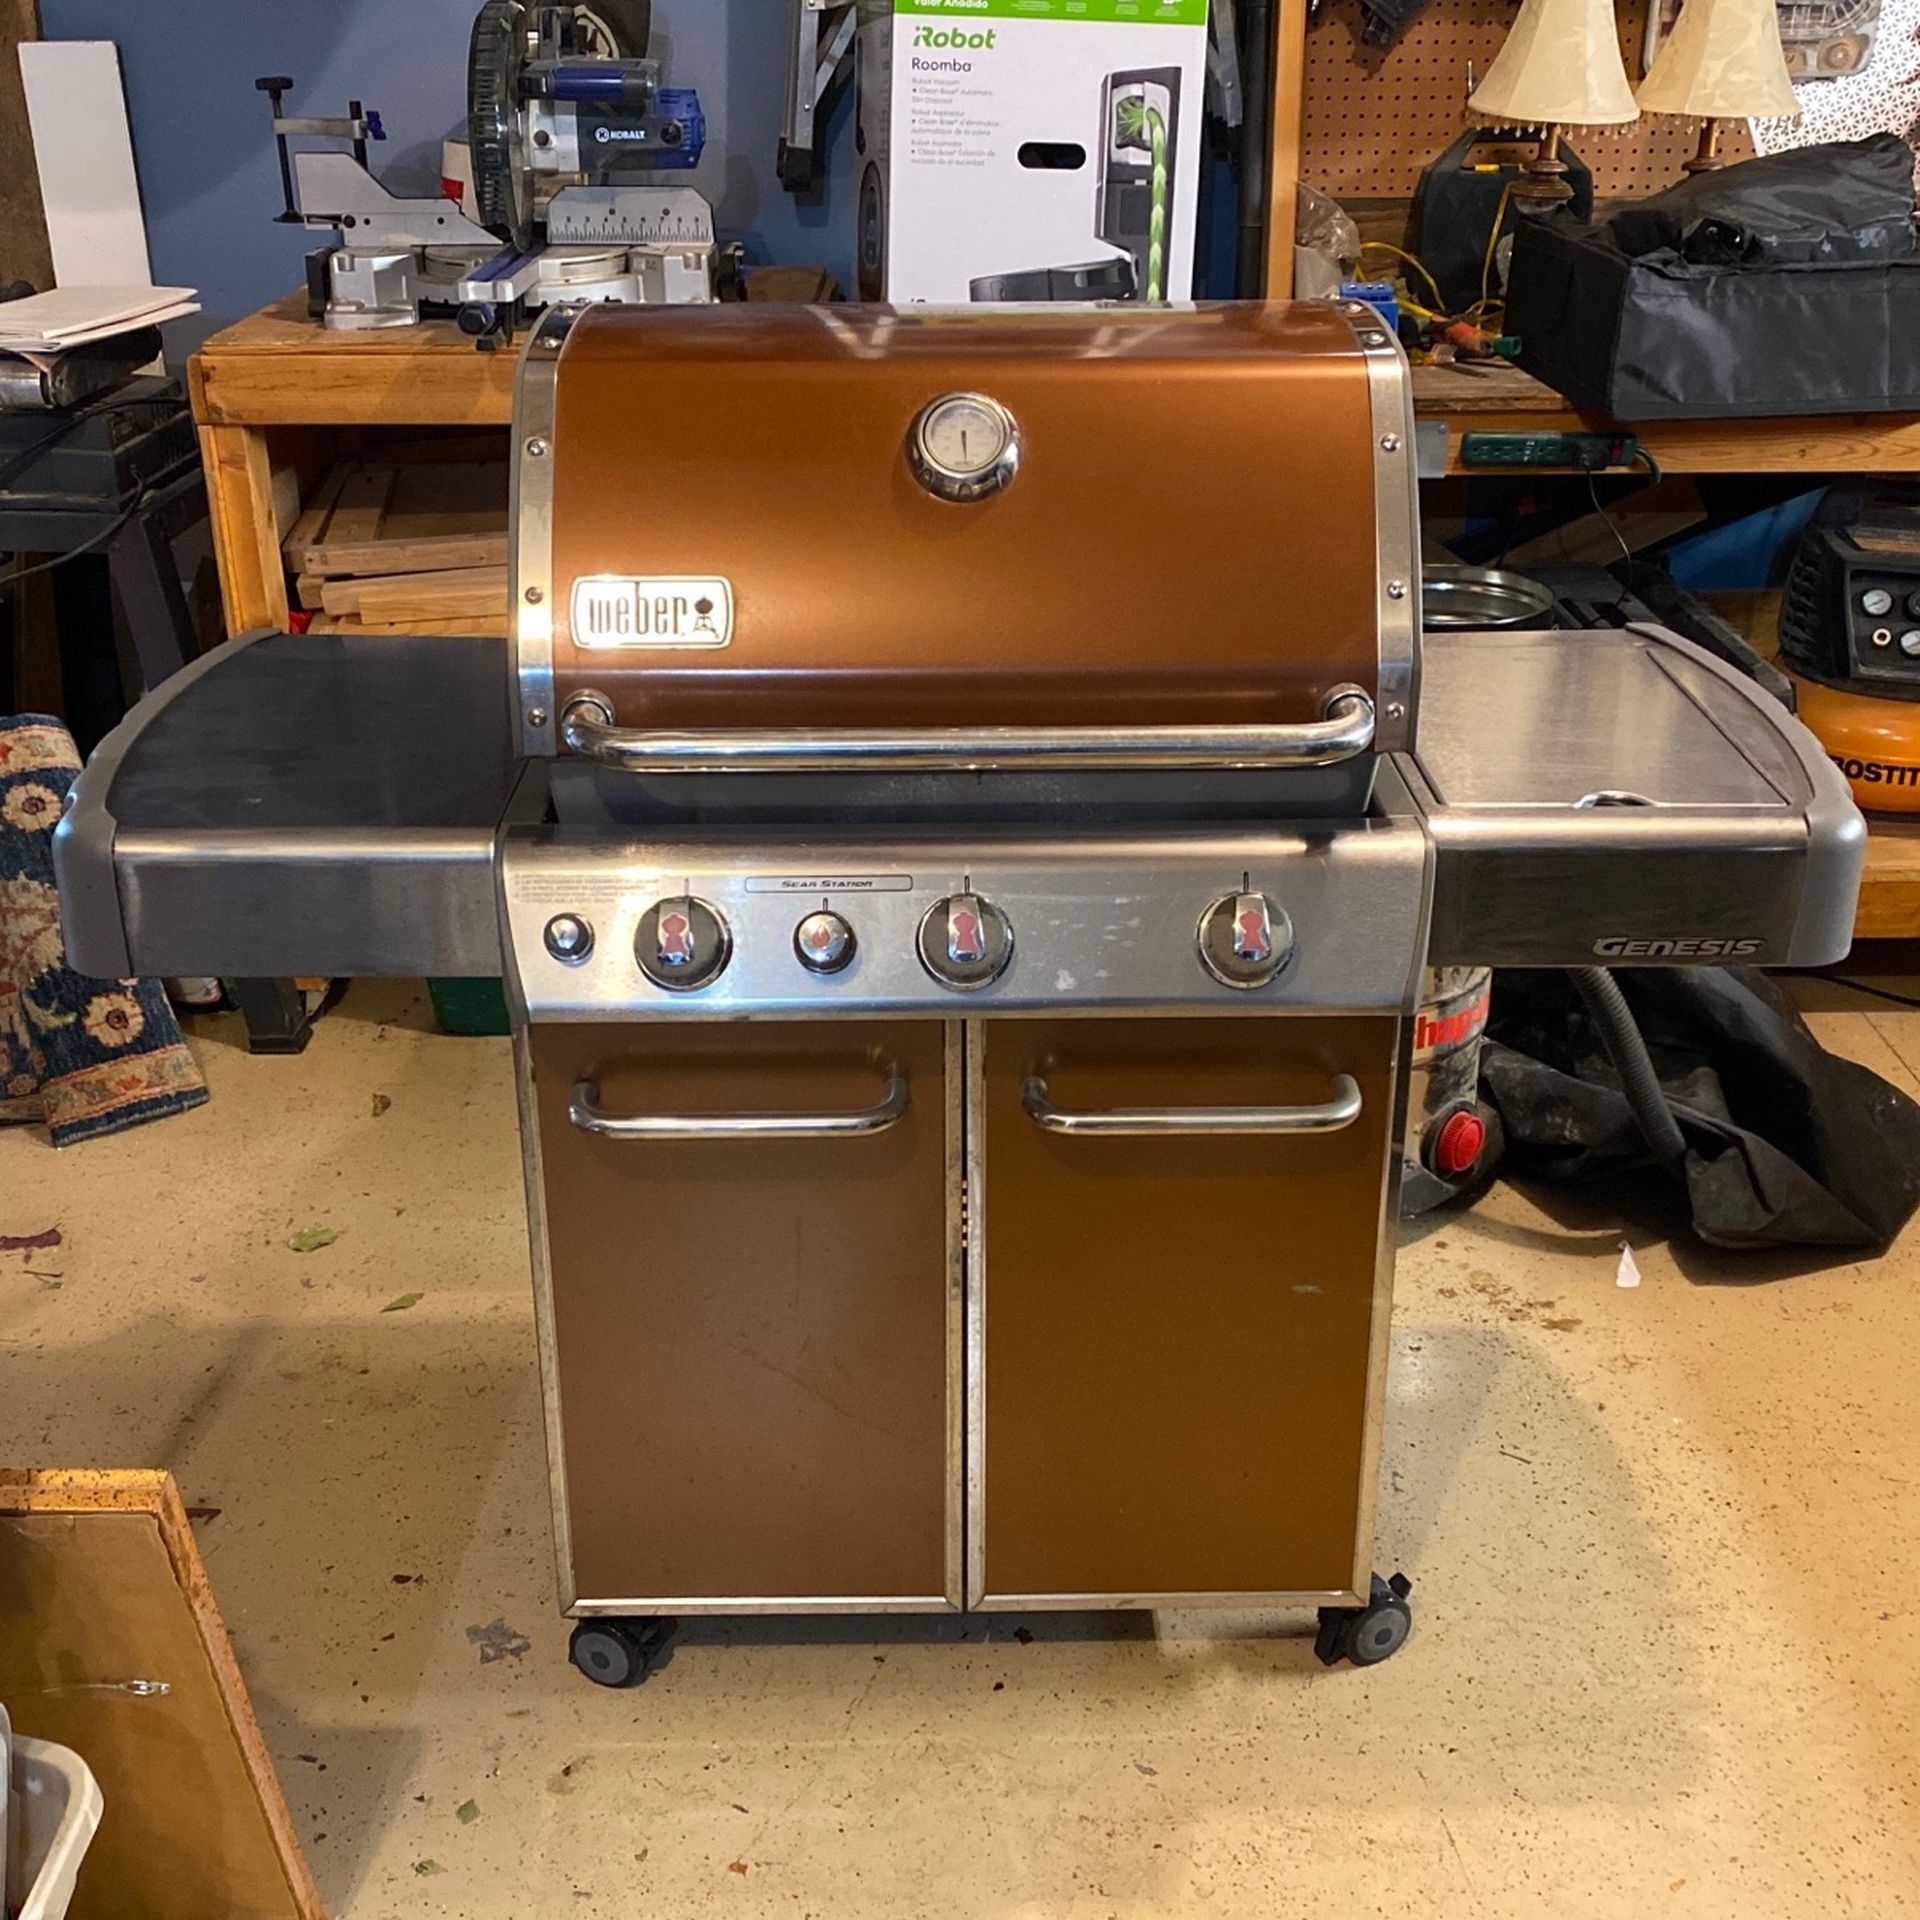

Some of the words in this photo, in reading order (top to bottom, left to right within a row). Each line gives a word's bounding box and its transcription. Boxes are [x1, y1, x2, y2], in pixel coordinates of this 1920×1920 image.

[913, 26, 996, 49] iRobot
[911, 57, 972, 72] Roomba
[610, 130, 646, 139] KOBALT
[588, 581, 688, 636] weber
[781, 879, 817, 888] SEAR
[820, 879, 873, 888] STATION
[1593, 936, 1764, 956] GENESIS
